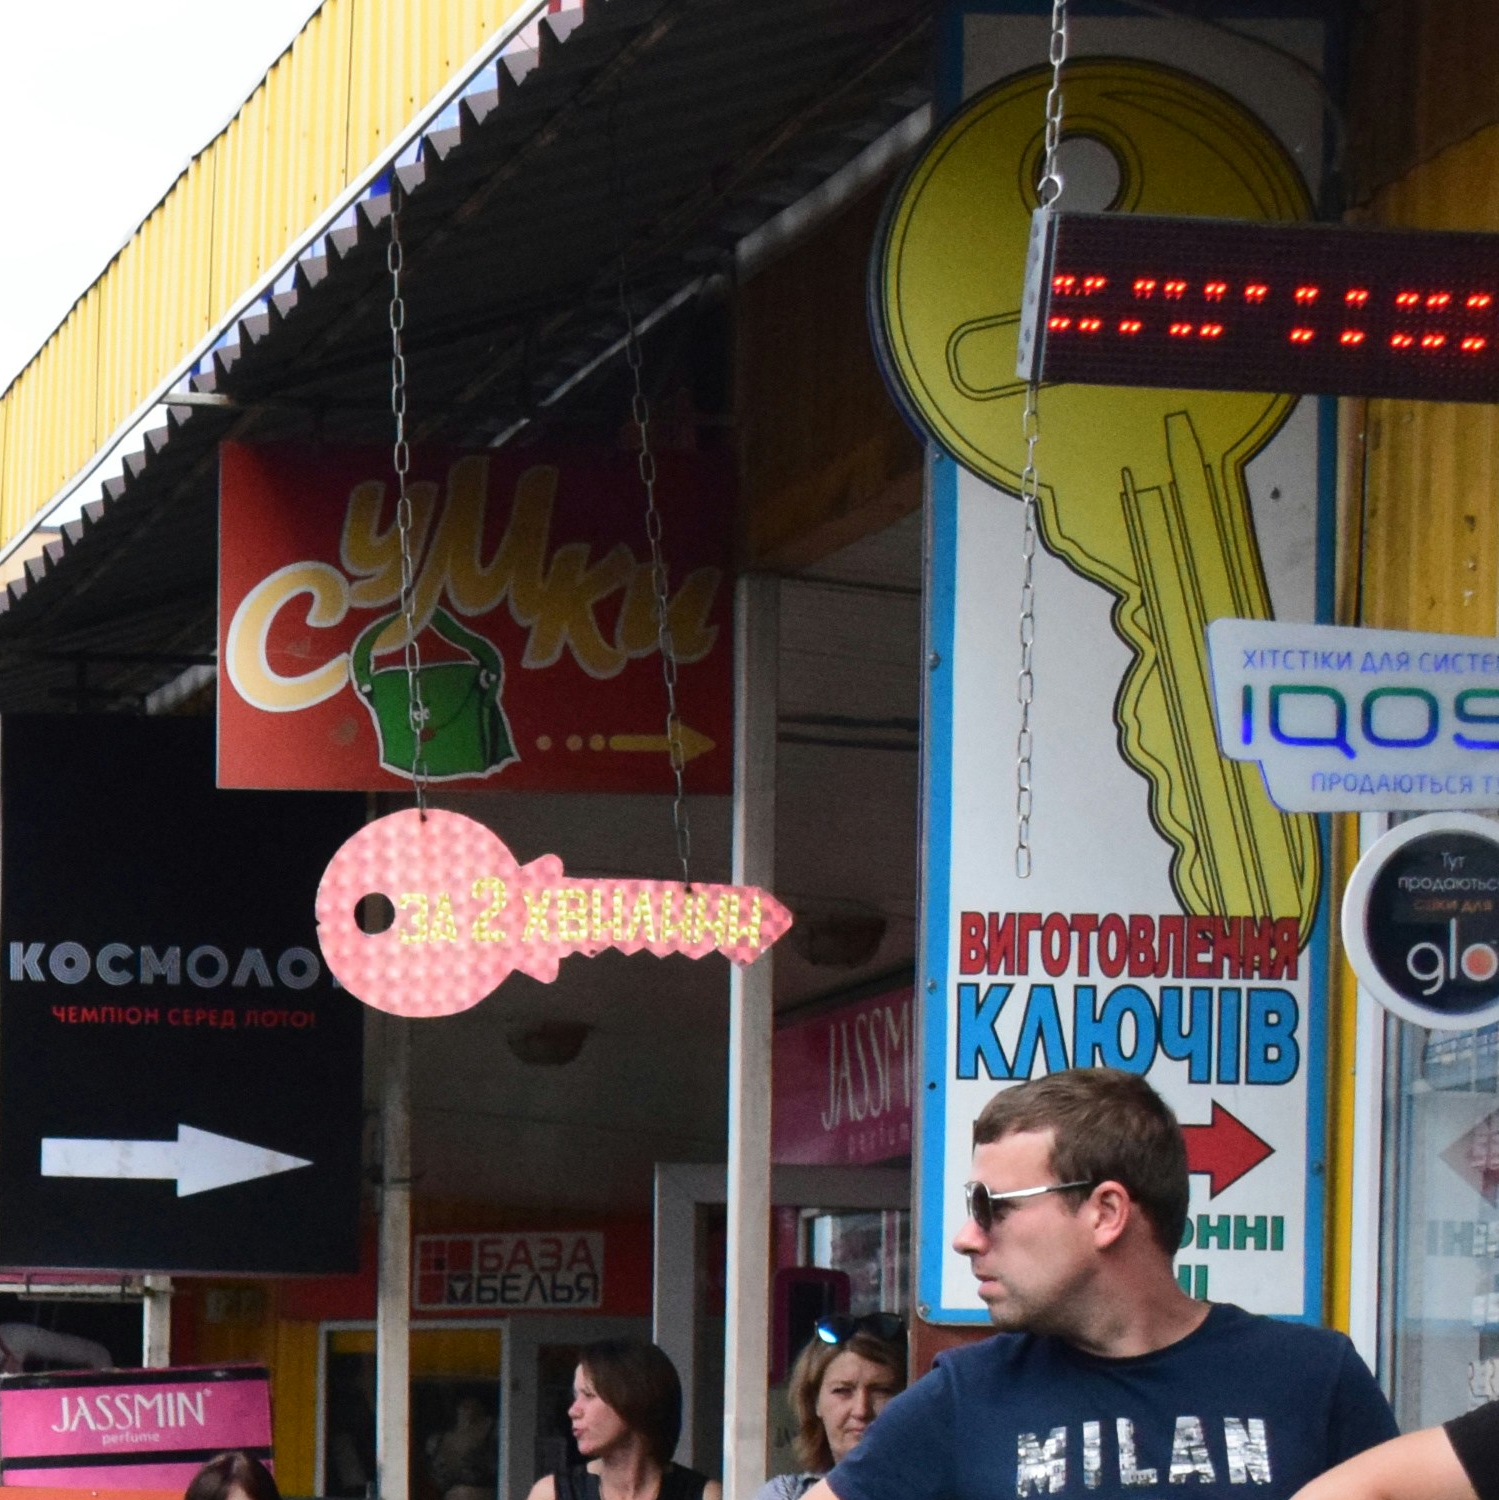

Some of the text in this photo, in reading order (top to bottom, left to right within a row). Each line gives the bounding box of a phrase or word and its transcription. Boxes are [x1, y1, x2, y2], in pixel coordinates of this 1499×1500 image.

[225, 455, 722, 712] Сумки
[1243, 649, 1352, 672] ХІТСТІКИ
[1360, 651, 1410, 674] ДЛЯ
[1242, 684, 1499, 760] IQOS
[1311, 772, 1473, 795] ПРОДАЮТЬСЯ
[1441, 851, 1466, 872] Тут
[1398, 876, 1499, 893] продаютьс
[398, 876, 763, 950] ЗА 2 ХВИЛИНИ
[9, 941, 344, 990] КОСМОЛО
[959, 911, 1302, 981] ВИГОТОВЛЕННЯ
[1406, 917, 1498, 996] glo
[52, 1005, 160, 1026] ЧЕМПІОН
[167, 1007, 236, 1029] СЕРЕД
[956, 982, 1300, 1085] КЛЮЧІВ
[477, 1237, 596, 1274] БАЗА
[476, 1273, 599, 1305] БЕЛЬЯ
[51, 1391, 204, 1433] JASSMIN
[102, 1430, 160, 1446] perfume
[1016, 1416, 1272, 1498] MILAN
